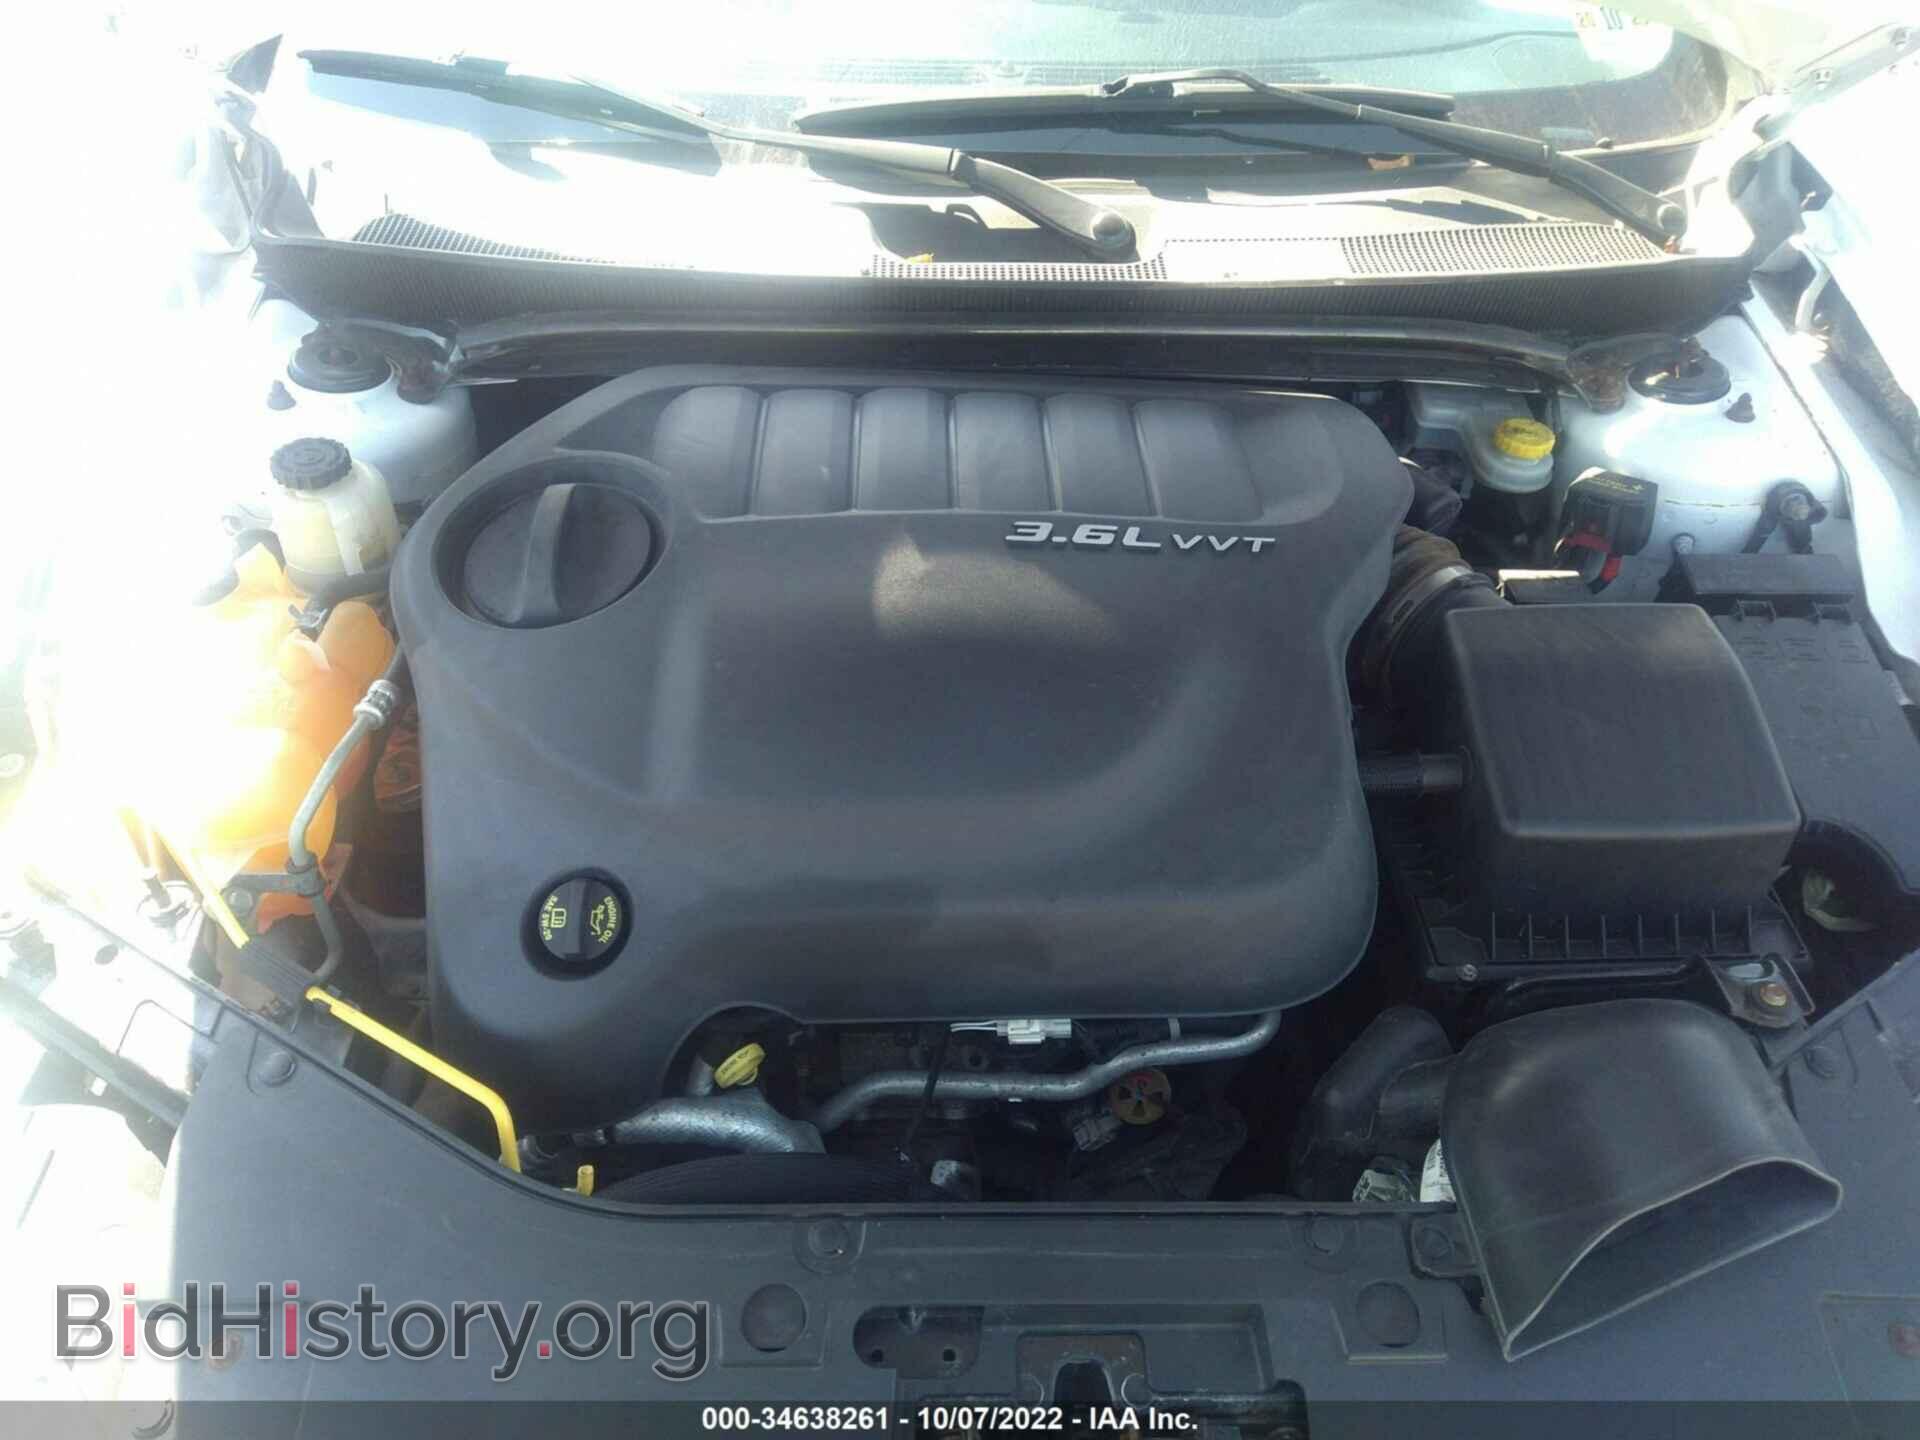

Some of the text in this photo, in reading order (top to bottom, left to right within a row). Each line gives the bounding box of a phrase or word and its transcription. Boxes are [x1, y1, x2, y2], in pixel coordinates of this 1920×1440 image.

[1005, 521, 1276, 553] 3.6L VVT
[597, 896, 617, 944] ENGINE OIL
